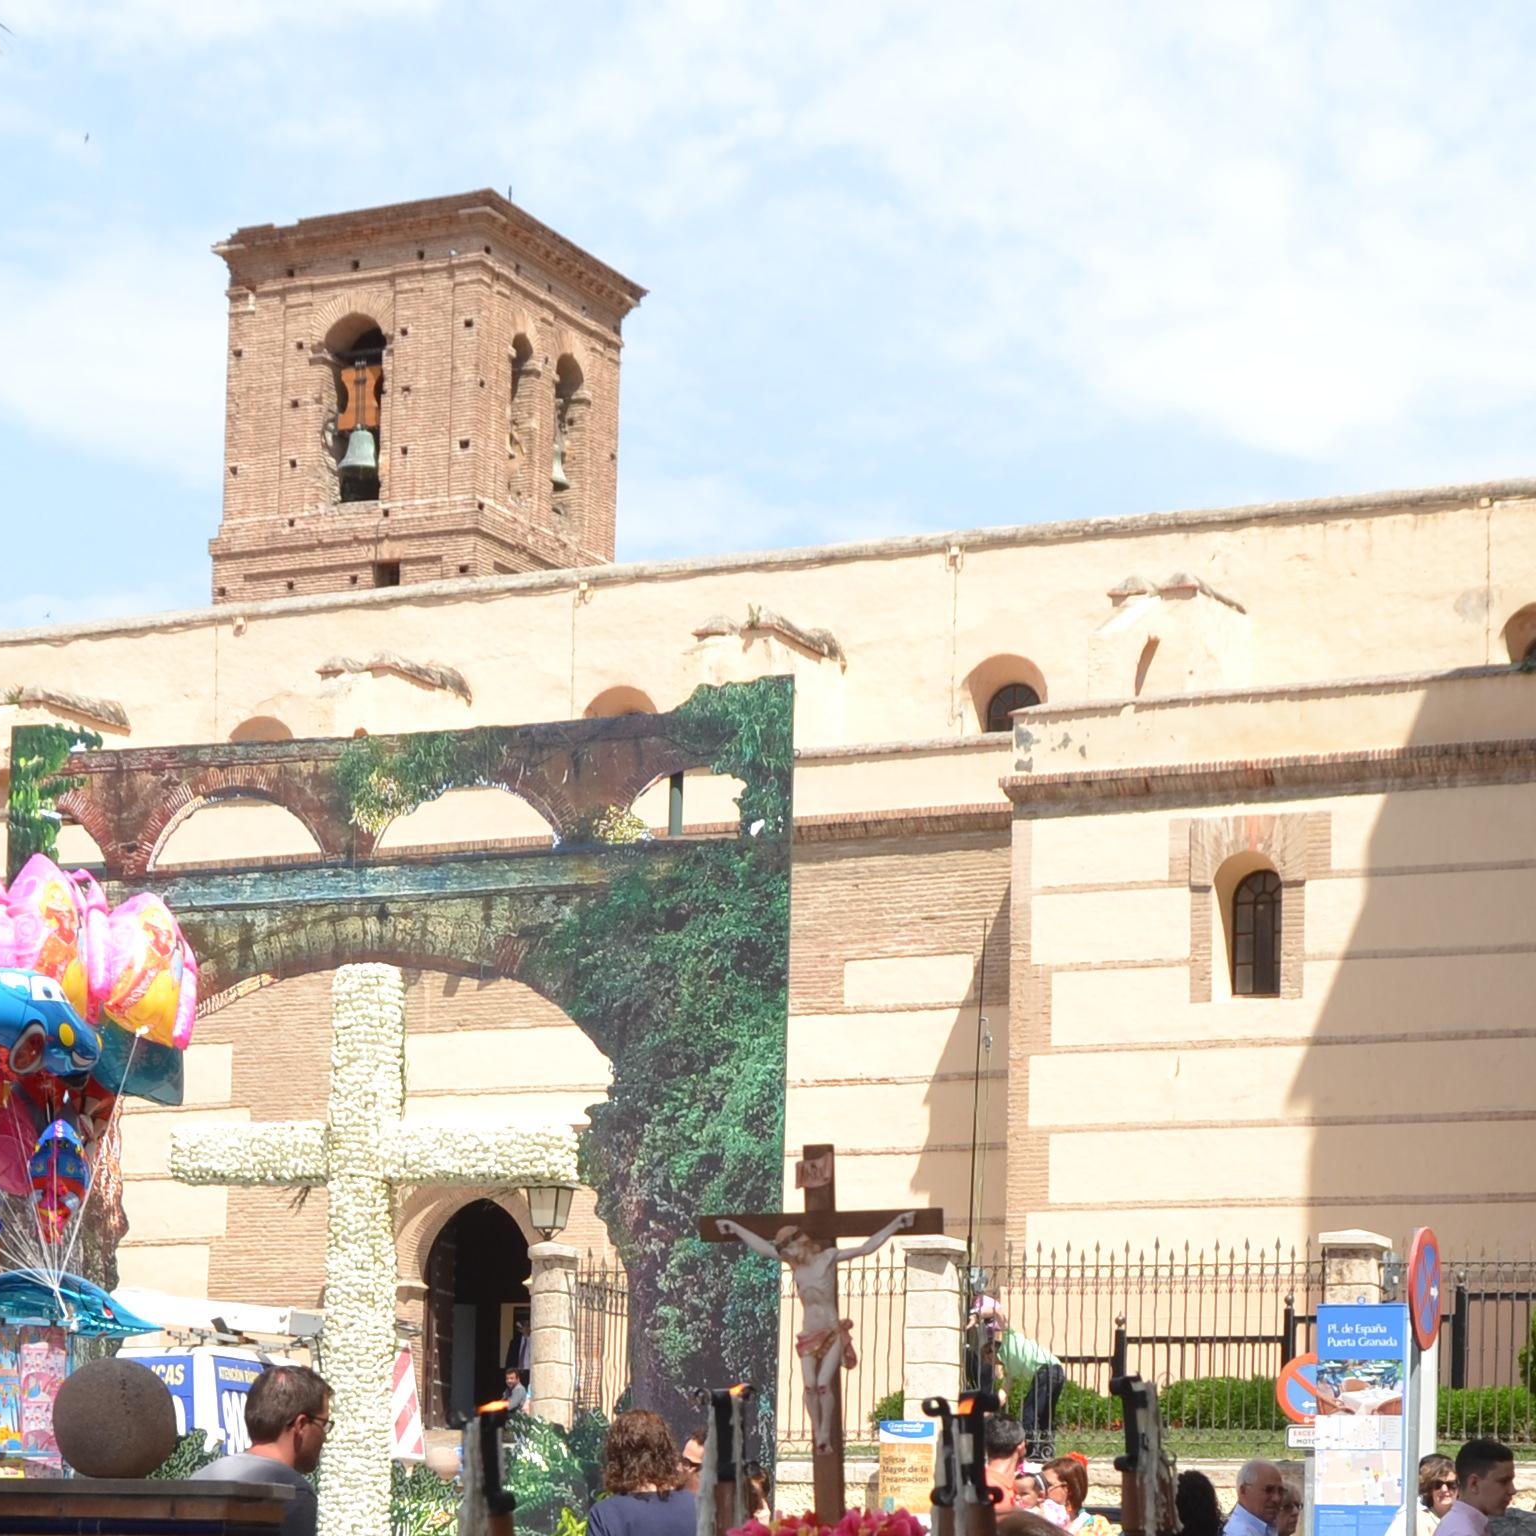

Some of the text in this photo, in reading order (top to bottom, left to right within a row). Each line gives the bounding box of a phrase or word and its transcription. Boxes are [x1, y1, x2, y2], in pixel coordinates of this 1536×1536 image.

[1341, 1323, 1353, 1333] de
[1356, 1323, 1387, 1336] España
[1327, 1336, 1398, 1347] Puerta Granada
